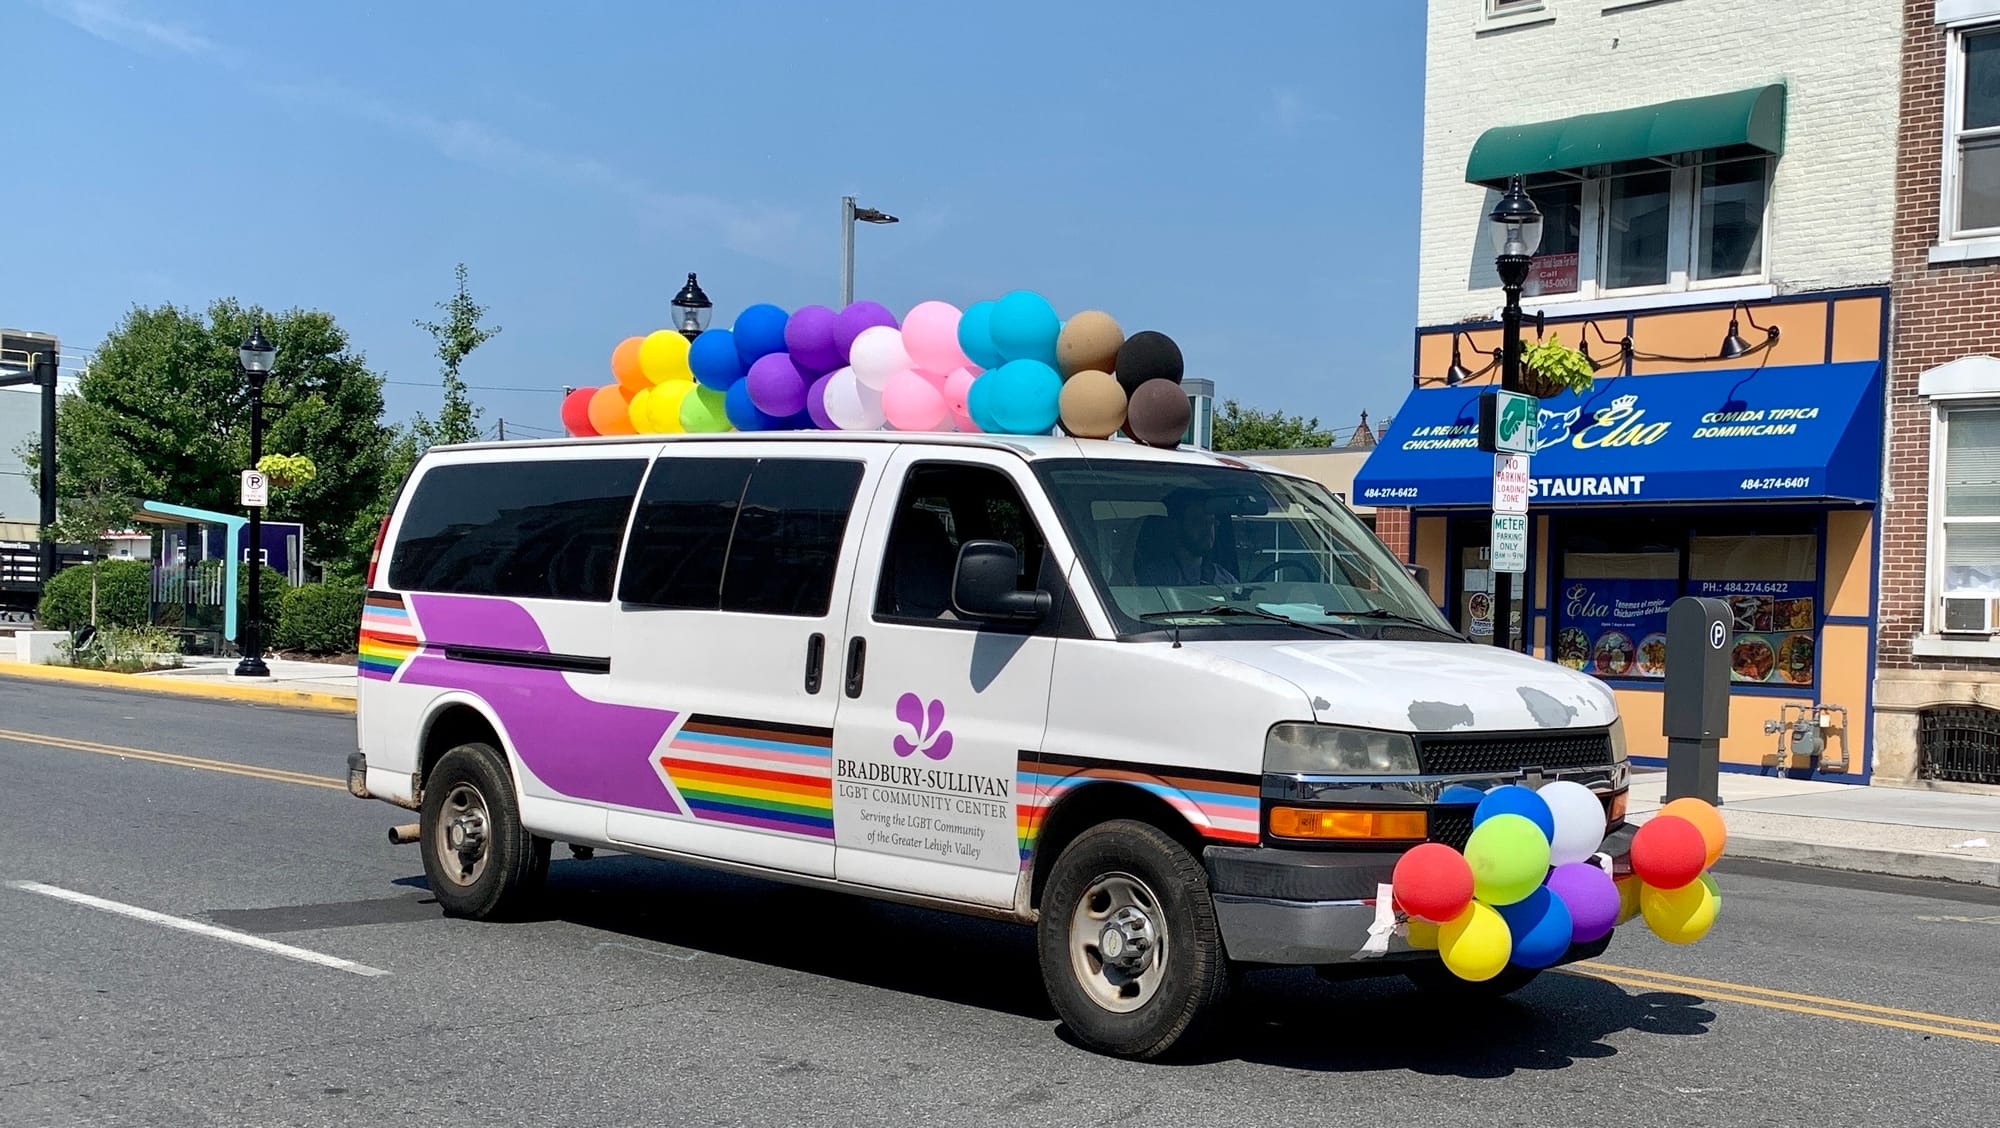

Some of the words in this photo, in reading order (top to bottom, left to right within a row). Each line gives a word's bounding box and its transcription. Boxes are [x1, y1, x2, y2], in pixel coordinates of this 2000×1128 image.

[1701, 410, 1765, 423] COMIDA
[1767, 407, 1819, 420] TIPICA
[1412, 427, 1428, 436] LA
[1430, 424, 1468, 436] REINA
[1572, 407, 1672, 449] Elsa
[1692, 424, 1797, 438] DOMINICANA
[1506, 459, 1519, 470] NO
[1497, 471, 1526, 482] PARKING
[1497, 485, 1525, 494] LOADING
[1528, 476, 1646, 497] STAURANT
[1740, 477, 1810, 490] 484-274-6401
[1364, 487, 1418, 498] 484-274-6422
[1502, 494, 1520, 503] ZONE
[1495, 518, 1525, 531] METER
[1496, 532, 1523, 541] PARKING
[1500, 542, 1518, 551] ONLY
[1724, 582, 1788, 593] 484.274.6422
[1566, 585, 1609, 620] Elsa
[837, 759, 1009, 798] BRADBURY-SULLIVAN
[839, 784, 868, 800] LGBT
[872, 788, 951, 811] COMMUNITY
[955, 799, 1007, 819] CENTER
[860, 809, 891, 828] Serving
[893, 813, 905, 826] the
[907, 815, 932, 830] LGBT
[934, 819, 986, 841] Community
[867, 830, 876, 845] of
[877, 831, 889, 844] the
[891, 833, 922, 849] Greater
[924, 837, 952, 856] Lehigh
[955, 842, 982, 861] Valley
